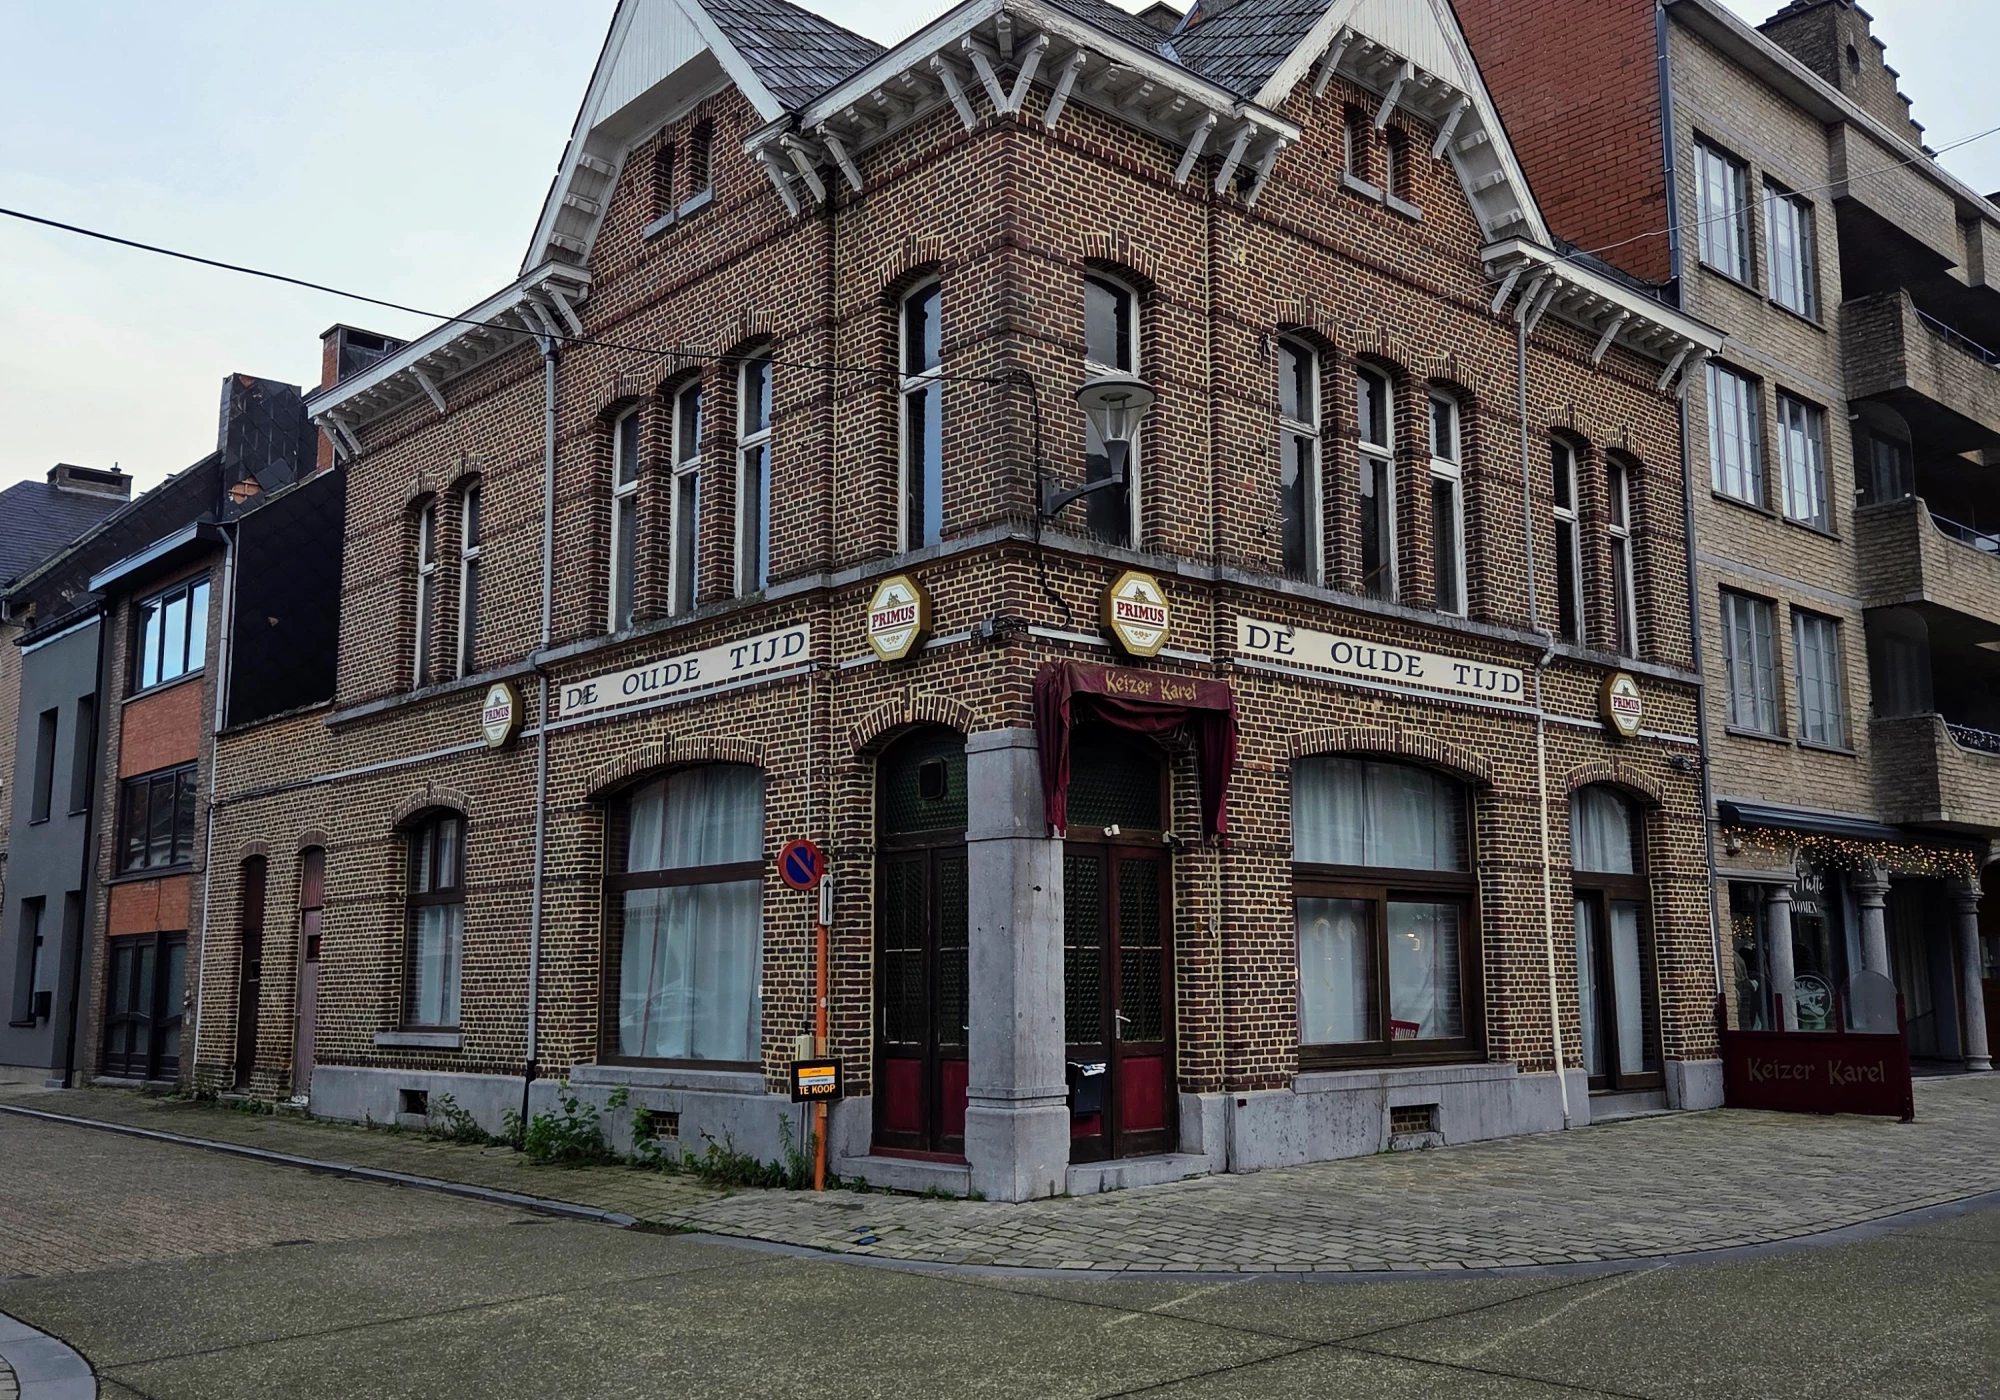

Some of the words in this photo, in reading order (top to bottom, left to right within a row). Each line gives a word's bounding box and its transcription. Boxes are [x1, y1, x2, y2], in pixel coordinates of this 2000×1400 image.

[871, 605, 915, 628] PRIMUS
[1116, 601, 1165, 623] PRIMUS
[1244, 624, 1296, 656] DE
[1330, 641, 1425, 678] OUDE
[1453, 663, 1521, 694] TIJD
[564, 683, 599, 710] DE
[622, 658, 702, 696] OUDE
[729, 631, 806, 670] TIJD
[1105, 670, 1153, 696] Keizer
[1160, 677, 1197, 701] Karel
[484, 705, 510, 722] PRIMUS
[1612, 696, 1641, 711] PRIMUS
[1789, 900, 1818, 914] WOMEN
[1747, 1057, 1816, 1083] Keizer
[1827, 1059, 1886, 1086] Karel
[798, 1085, 810, 1096] TE
[811, 1084, 836, 1095] KOOP
